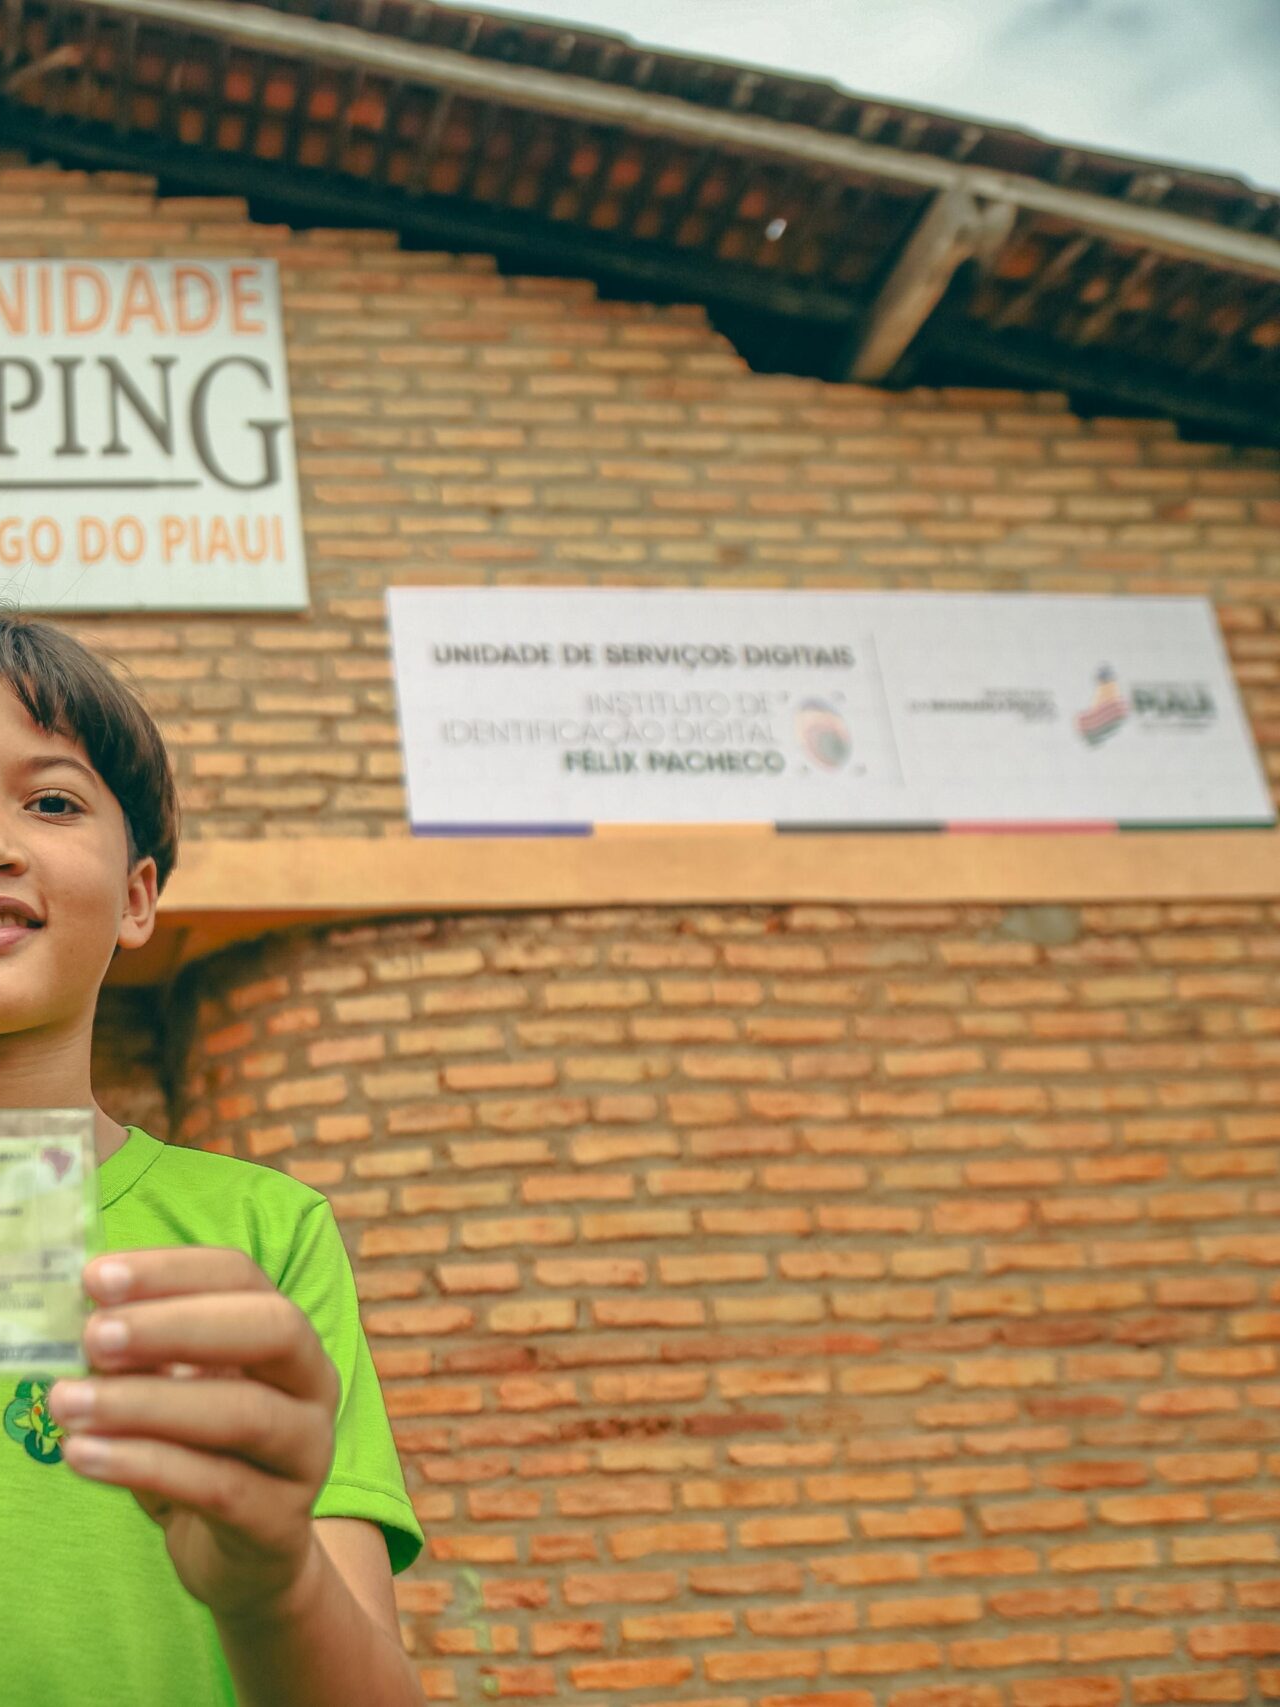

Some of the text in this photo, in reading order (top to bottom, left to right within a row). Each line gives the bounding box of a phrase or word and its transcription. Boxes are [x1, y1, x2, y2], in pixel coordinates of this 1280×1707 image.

[77, 515, 146, 566] DO
[160, 514, 285, 563] PIAUI
[433, 642, 855, 673] UNIDADE DE SERVIÇOS DIGITAIS
[648, 750, 785, 775] PACHECO
